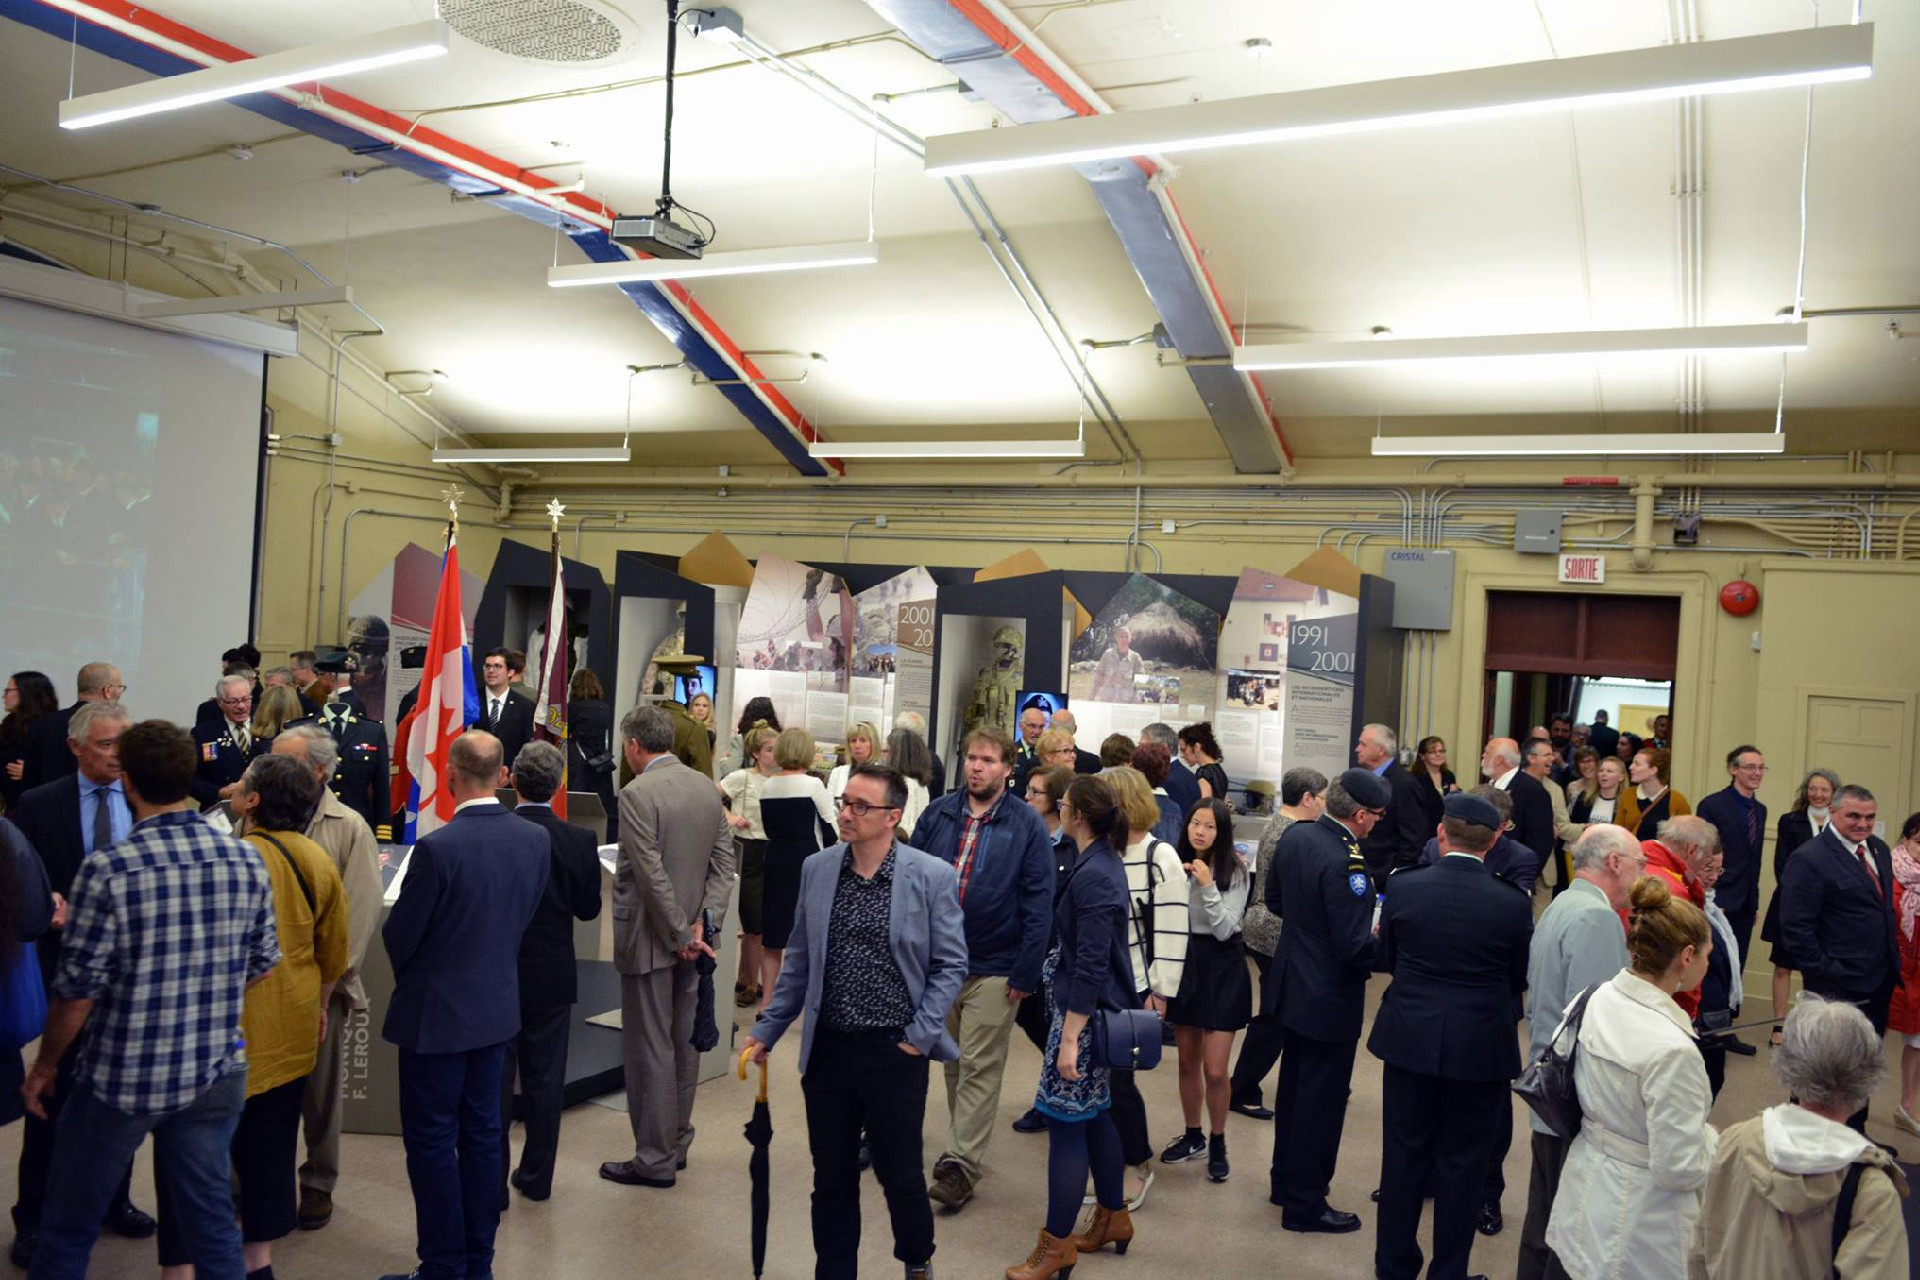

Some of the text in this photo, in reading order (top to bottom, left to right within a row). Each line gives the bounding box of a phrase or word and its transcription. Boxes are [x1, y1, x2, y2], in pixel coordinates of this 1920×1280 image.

[1391, 552, 1425, 560] CRISTAL
[1565, 558, 1599, 580] SORTIE
[900, 605, 935, 625] 2001
[913, 628, 934, 647] 20
[1292, 625, 1328, 646] 1991
[1311, 651, 1354, 672] 2001
[353, 1085, 368, 1099] F.
